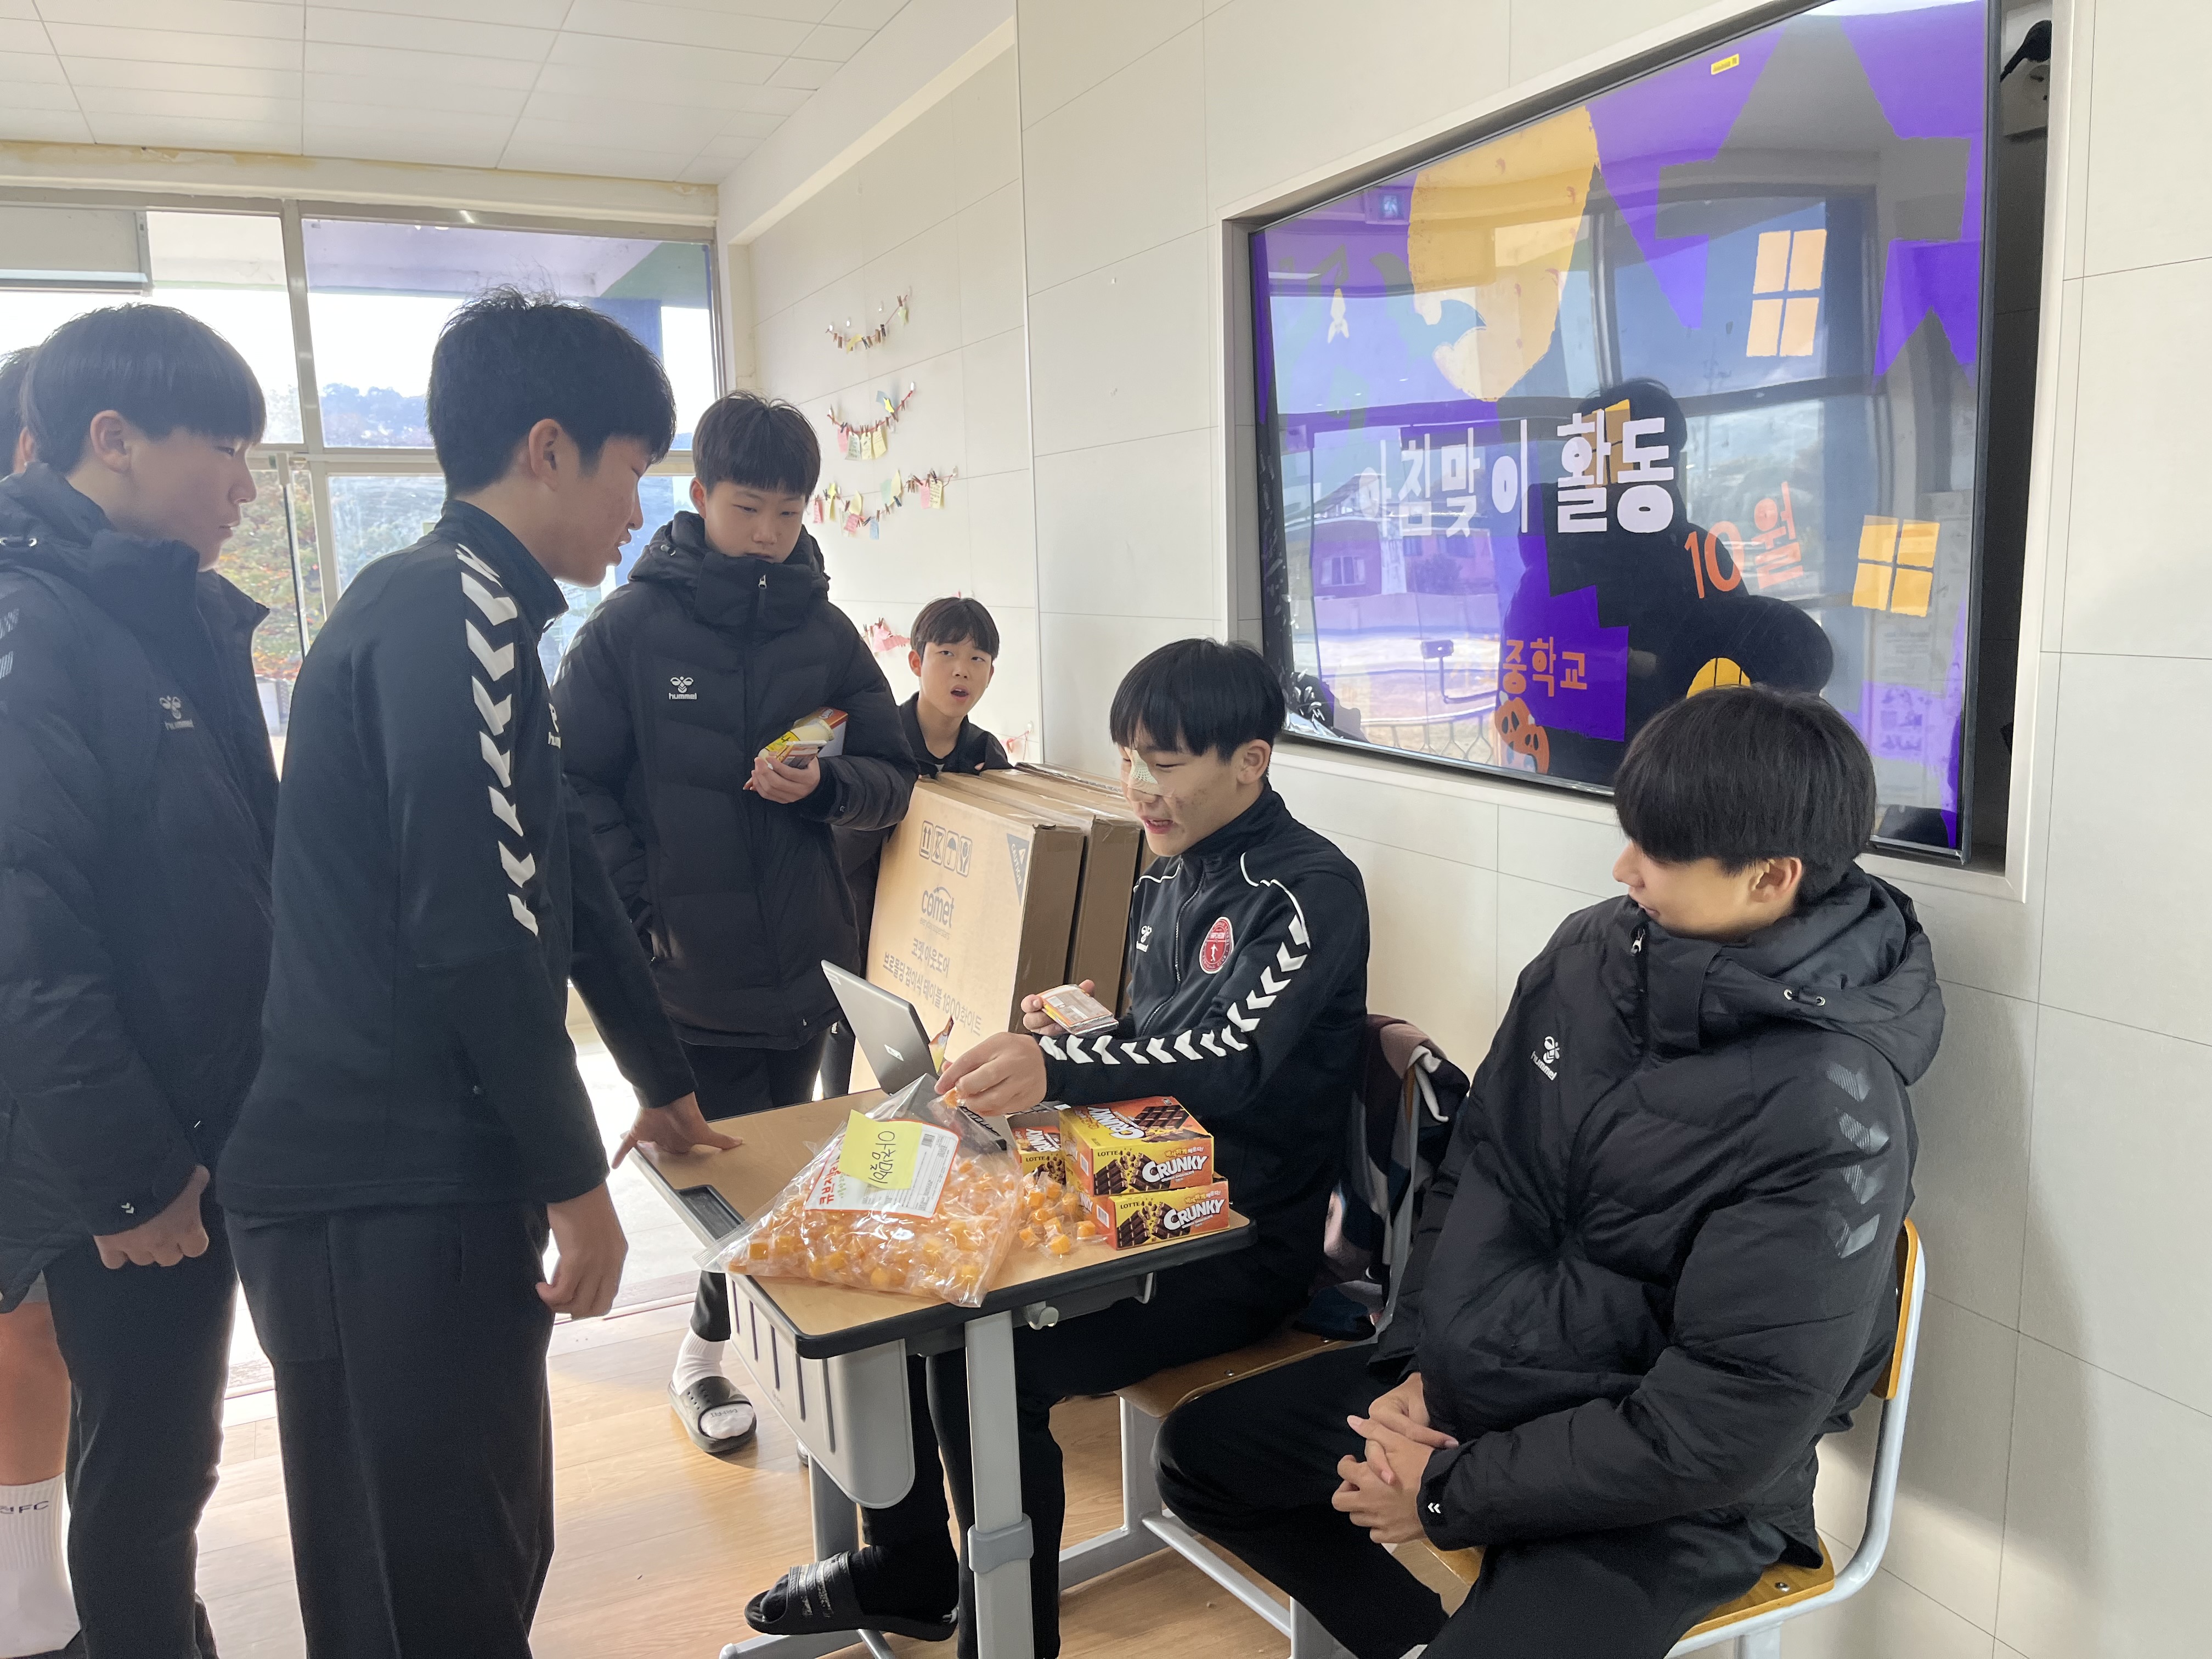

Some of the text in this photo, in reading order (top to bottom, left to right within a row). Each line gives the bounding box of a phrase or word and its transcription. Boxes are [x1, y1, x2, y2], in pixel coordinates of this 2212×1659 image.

[1359, 409, 1674, 538] 아침맞이 활동
[1684, 481, 1804, 599] 10월
[1011, 843, 1022, 886] CAUTION
[921, 890, 955, 928] comet
[911, 938, 950, 978] 코멧 아웃도어
[905, 966, 923, 996] 접이식
[923, 979, 942, 1009] 테이블
[1531, 1051, 1558, 1081] hummel
[1025, 1128, 1058, 1152] RUNKY
[1087, 1106, 1147, 1139] CRUNKY
[868, 1130, 896, 1184] 아침맞이
[1142, 1155, 1209, 1183] CRUNKY
[1120, 1201, 1141, 1209] LOTTE
[1164, 1199, 1225, 1231] CRUNKY
